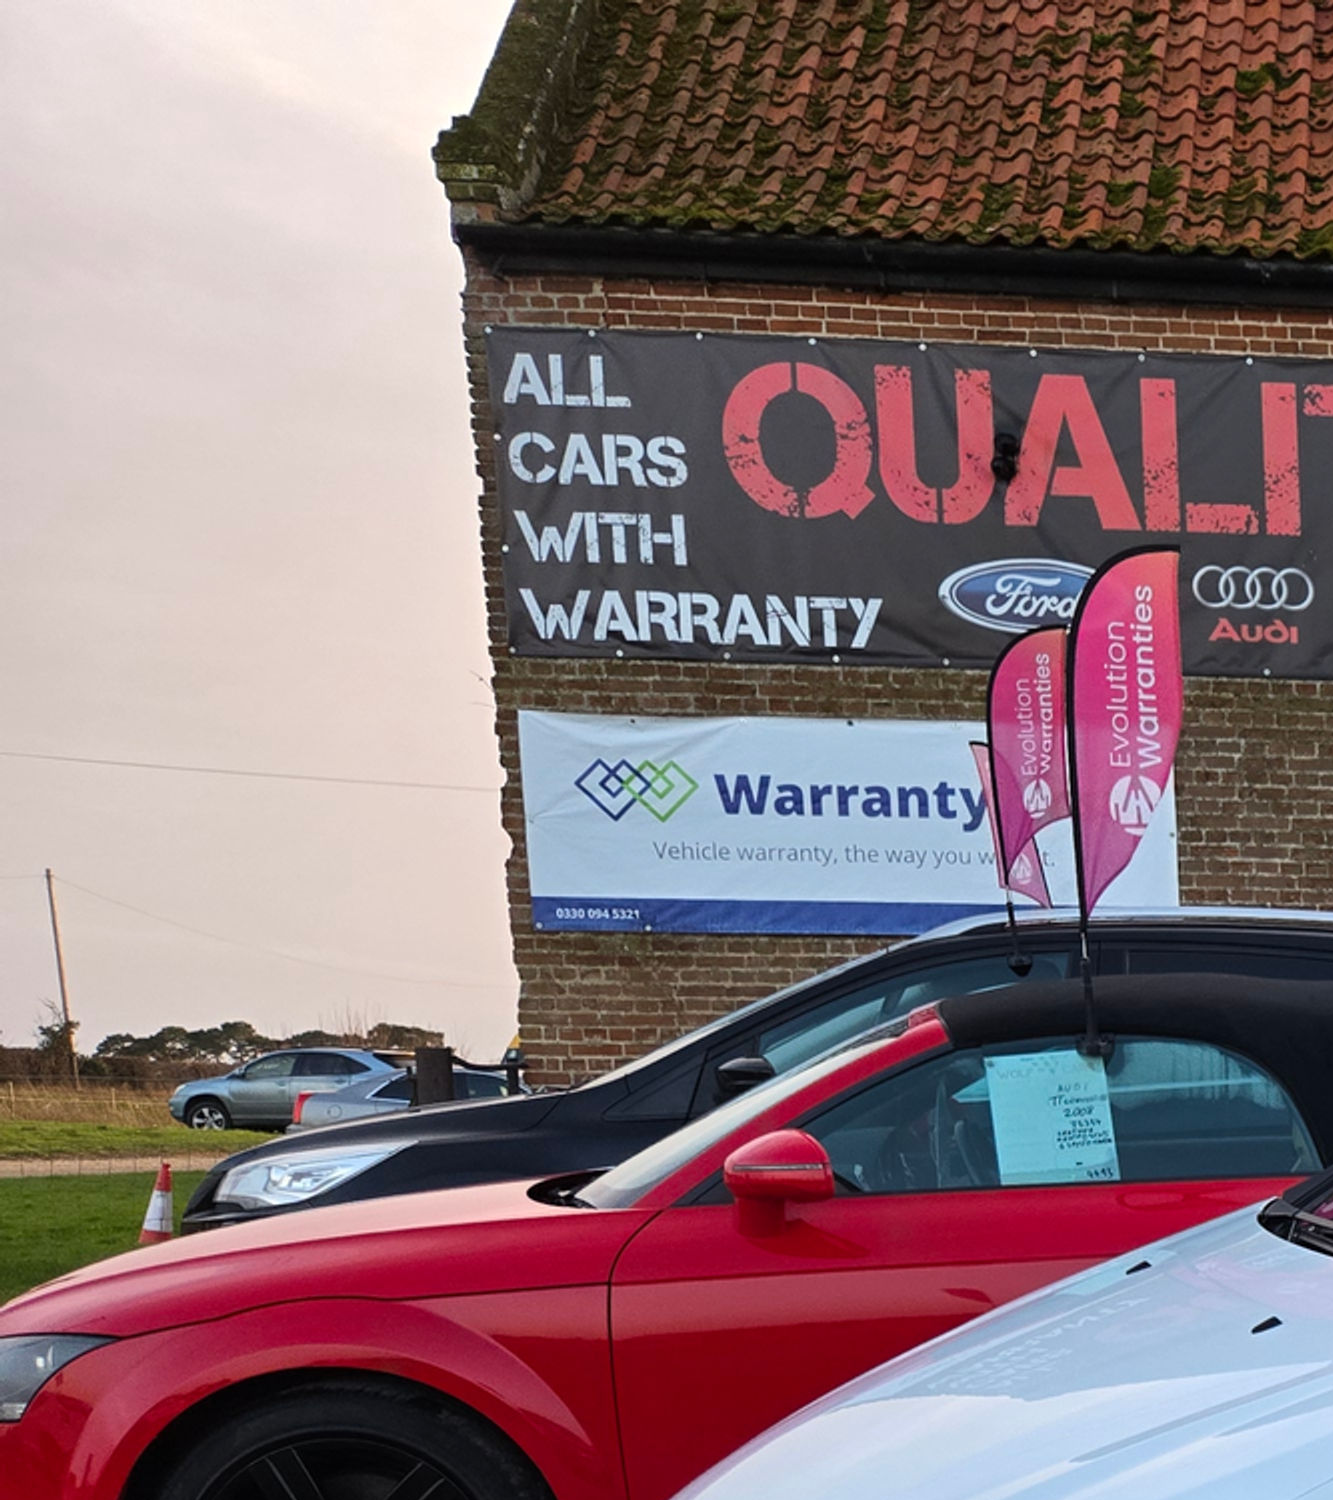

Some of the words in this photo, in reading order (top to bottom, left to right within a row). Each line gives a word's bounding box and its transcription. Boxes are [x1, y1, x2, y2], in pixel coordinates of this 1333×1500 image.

[503, 352, 632, 408] ALL
[508, 431, 688, 488] CARS
[513, 509, 688, 566] WITH
[518, 588, 883, 649] WARRANTY
[985, 574, 1078, 618] Ford
[1209, 617, 1299, 644] Audi
[1105, 620, 1131, 768] Evolution
[1131, 585, 1158, 768] Warranties
[1016, 677, 1038, 777] Evolution
[1033, 651, 1055, 775] Warranties
[714, 773, 986, 832] Warranty
[653, 841, 730, 862] Vehicle
[737, 845, 838, 867] warranty,
[844, 844, 878, 863] the
[886, 849, 927, 869] way
[932, 850, 971, 869] you
[978, 850, 1056, 868] wt.
[555, 907, 586, 920] 0330
[612, 909, 640, 920] 5321
